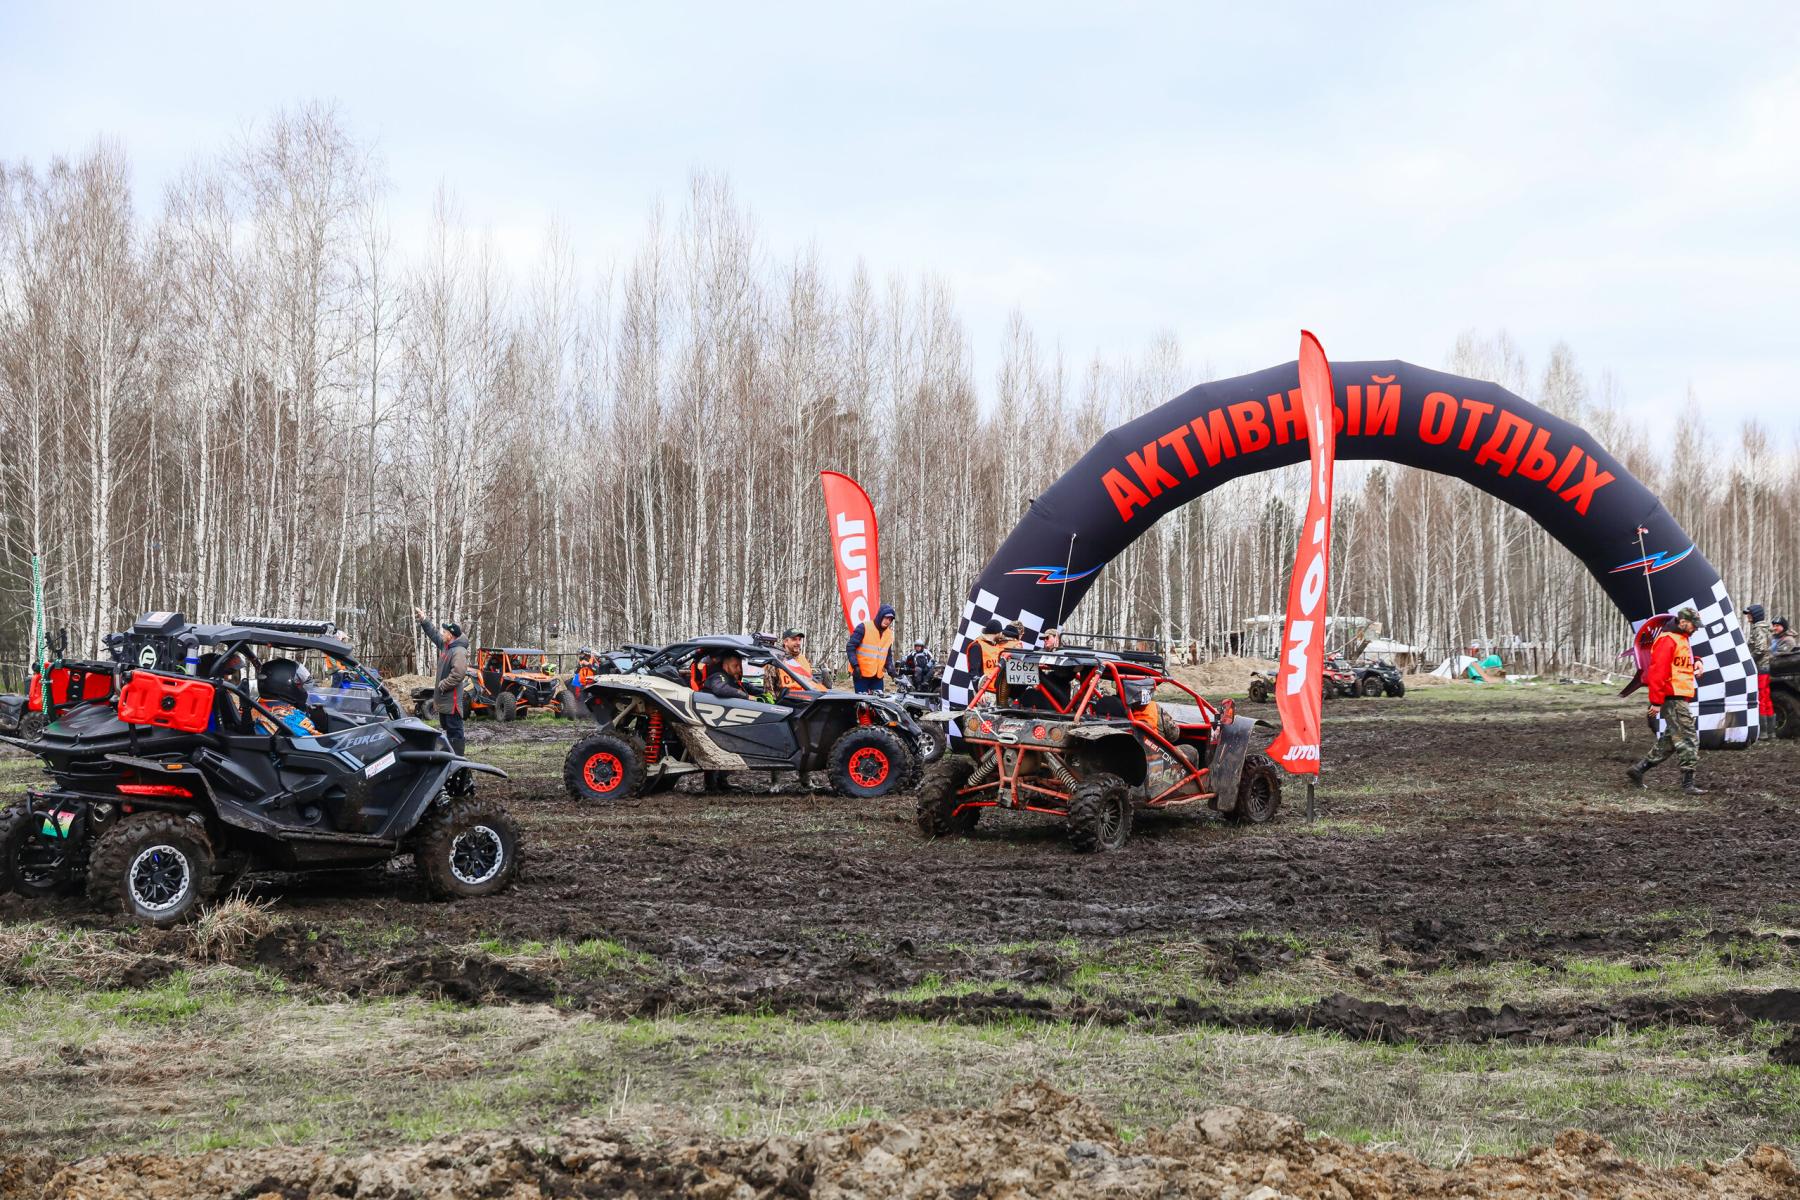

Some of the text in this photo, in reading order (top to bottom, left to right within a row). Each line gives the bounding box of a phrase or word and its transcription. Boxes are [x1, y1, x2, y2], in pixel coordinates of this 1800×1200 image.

[1418, 392, 1616, 516] ОТДЫХ
[836, 512, 871, 630] JUTO
[1010, 661, 1035, 672] 2662
[1026, 674, 1037, 684] 54
